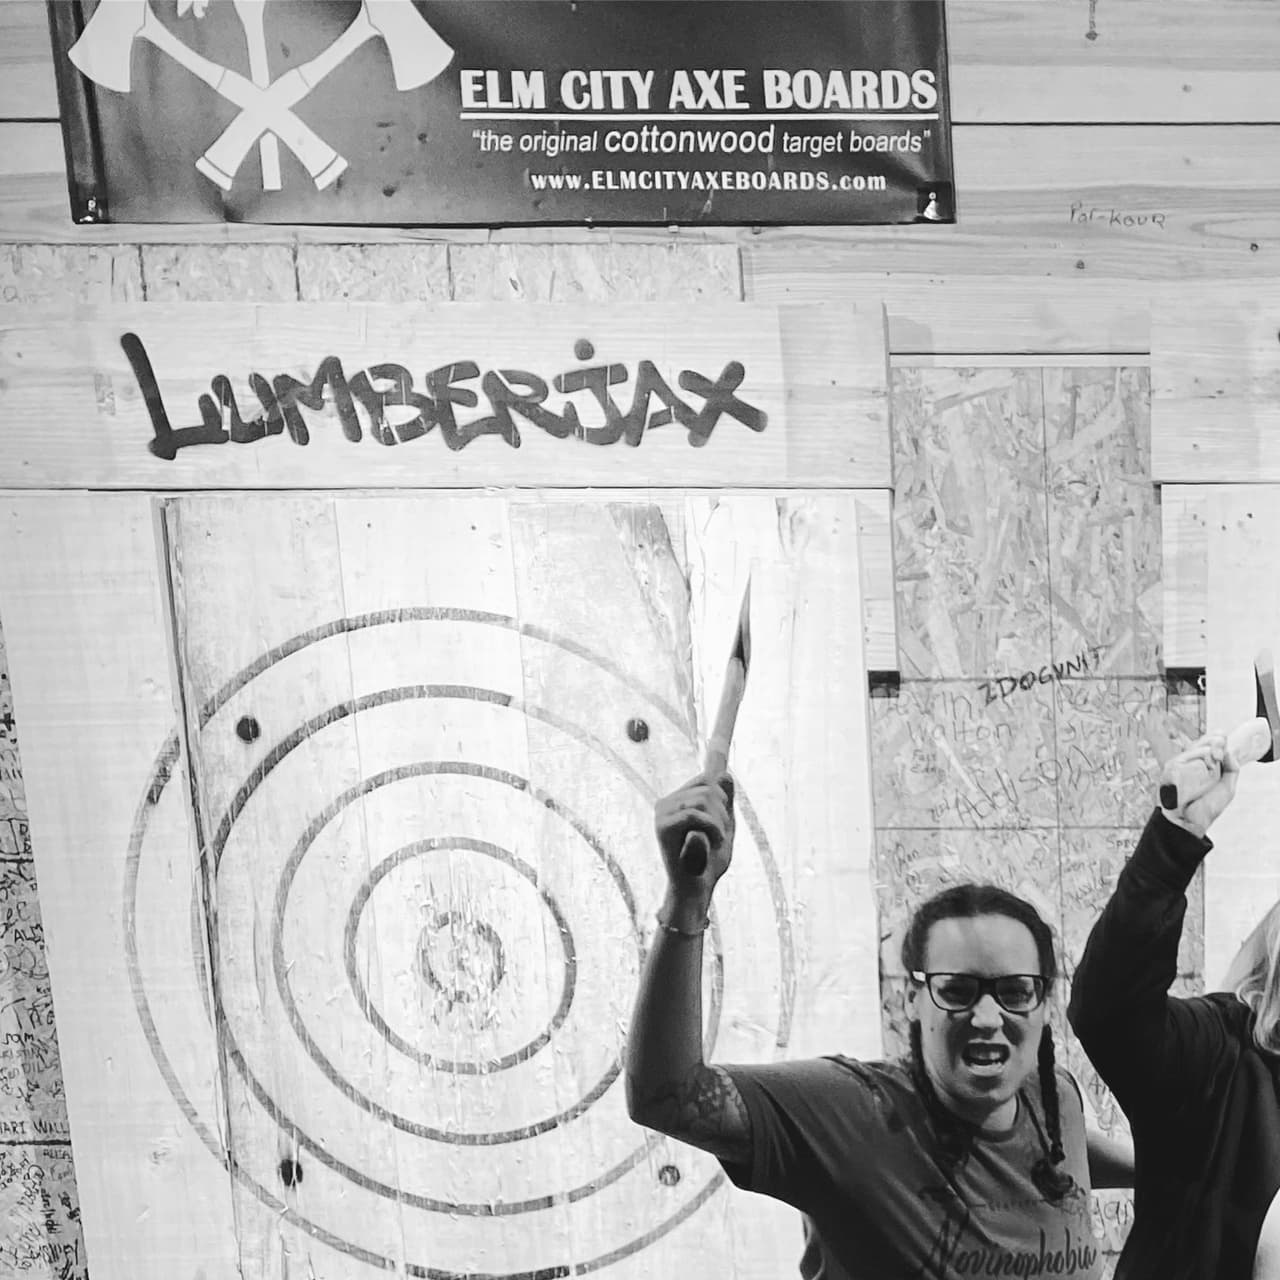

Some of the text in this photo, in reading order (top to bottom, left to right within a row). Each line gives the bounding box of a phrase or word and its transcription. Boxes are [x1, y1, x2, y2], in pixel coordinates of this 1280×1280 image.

[460, 69, 938, 110] ELM CITY AXE BOARDS
[519, 130, 598, 157] original
[604, 124, 775, 153] cottonwood
[782, 132, 844, 157] target
[530, 169, 887, 192] www.ELMCITYAXEBOARDS.com
